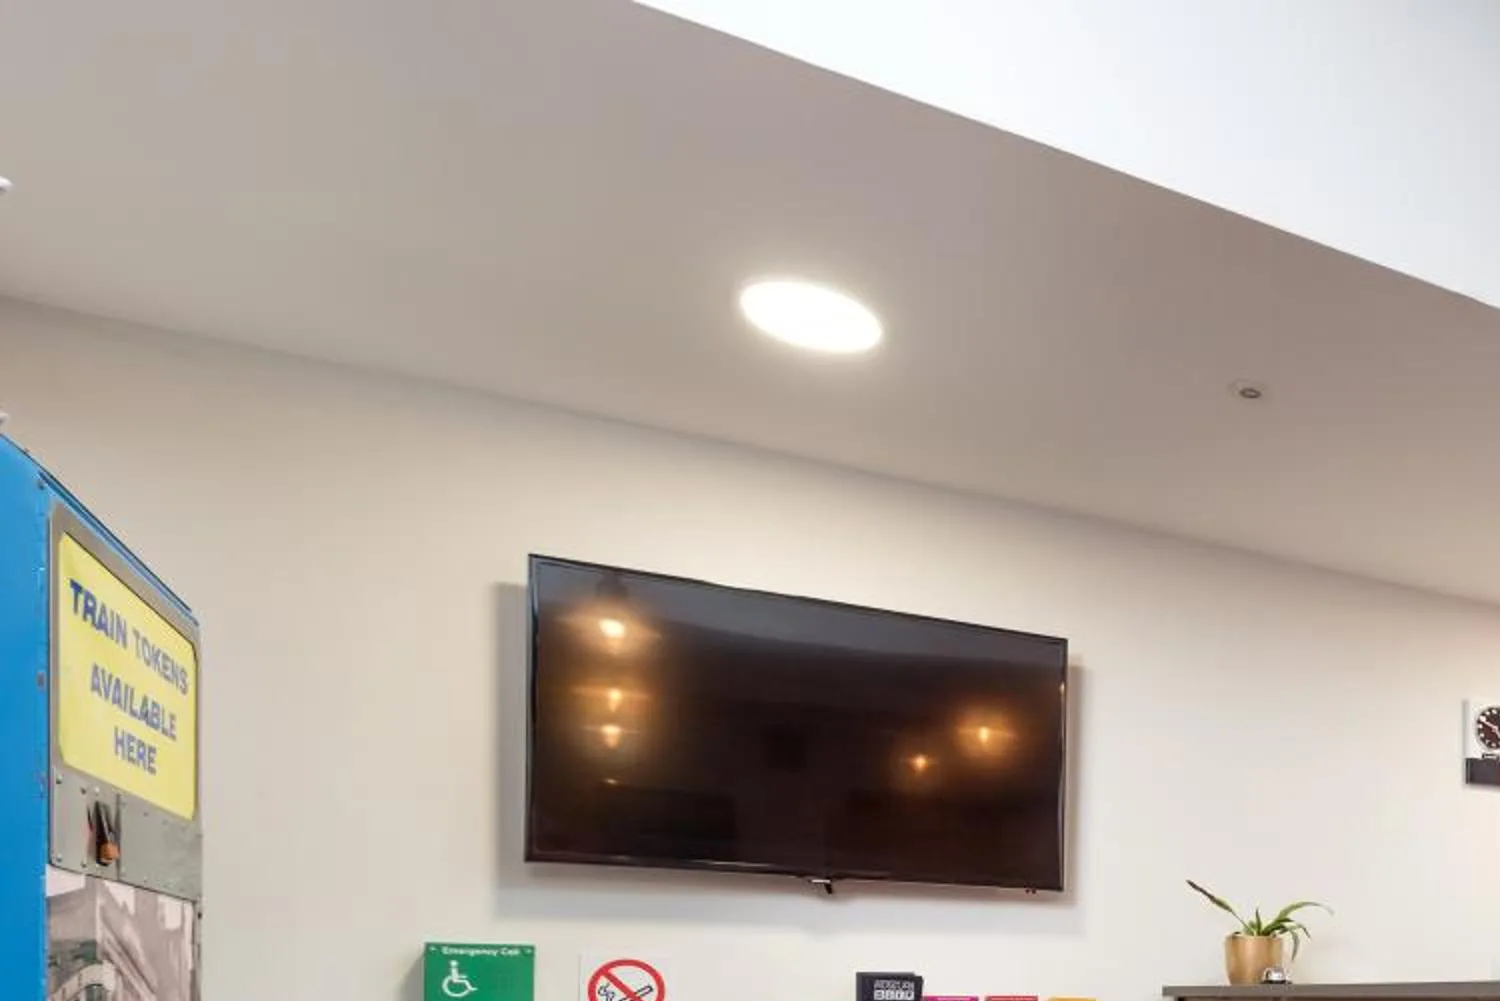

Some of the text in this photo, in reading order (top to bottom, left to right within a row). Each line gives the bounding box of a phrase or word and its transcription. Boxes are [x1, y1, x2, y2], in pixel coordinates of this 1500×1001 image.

[69, 577, 189, 696] TRAIN TOKENS
[90, 662, 177, 741] AVAILABLE
[113, 726, 157, 776] HERE
